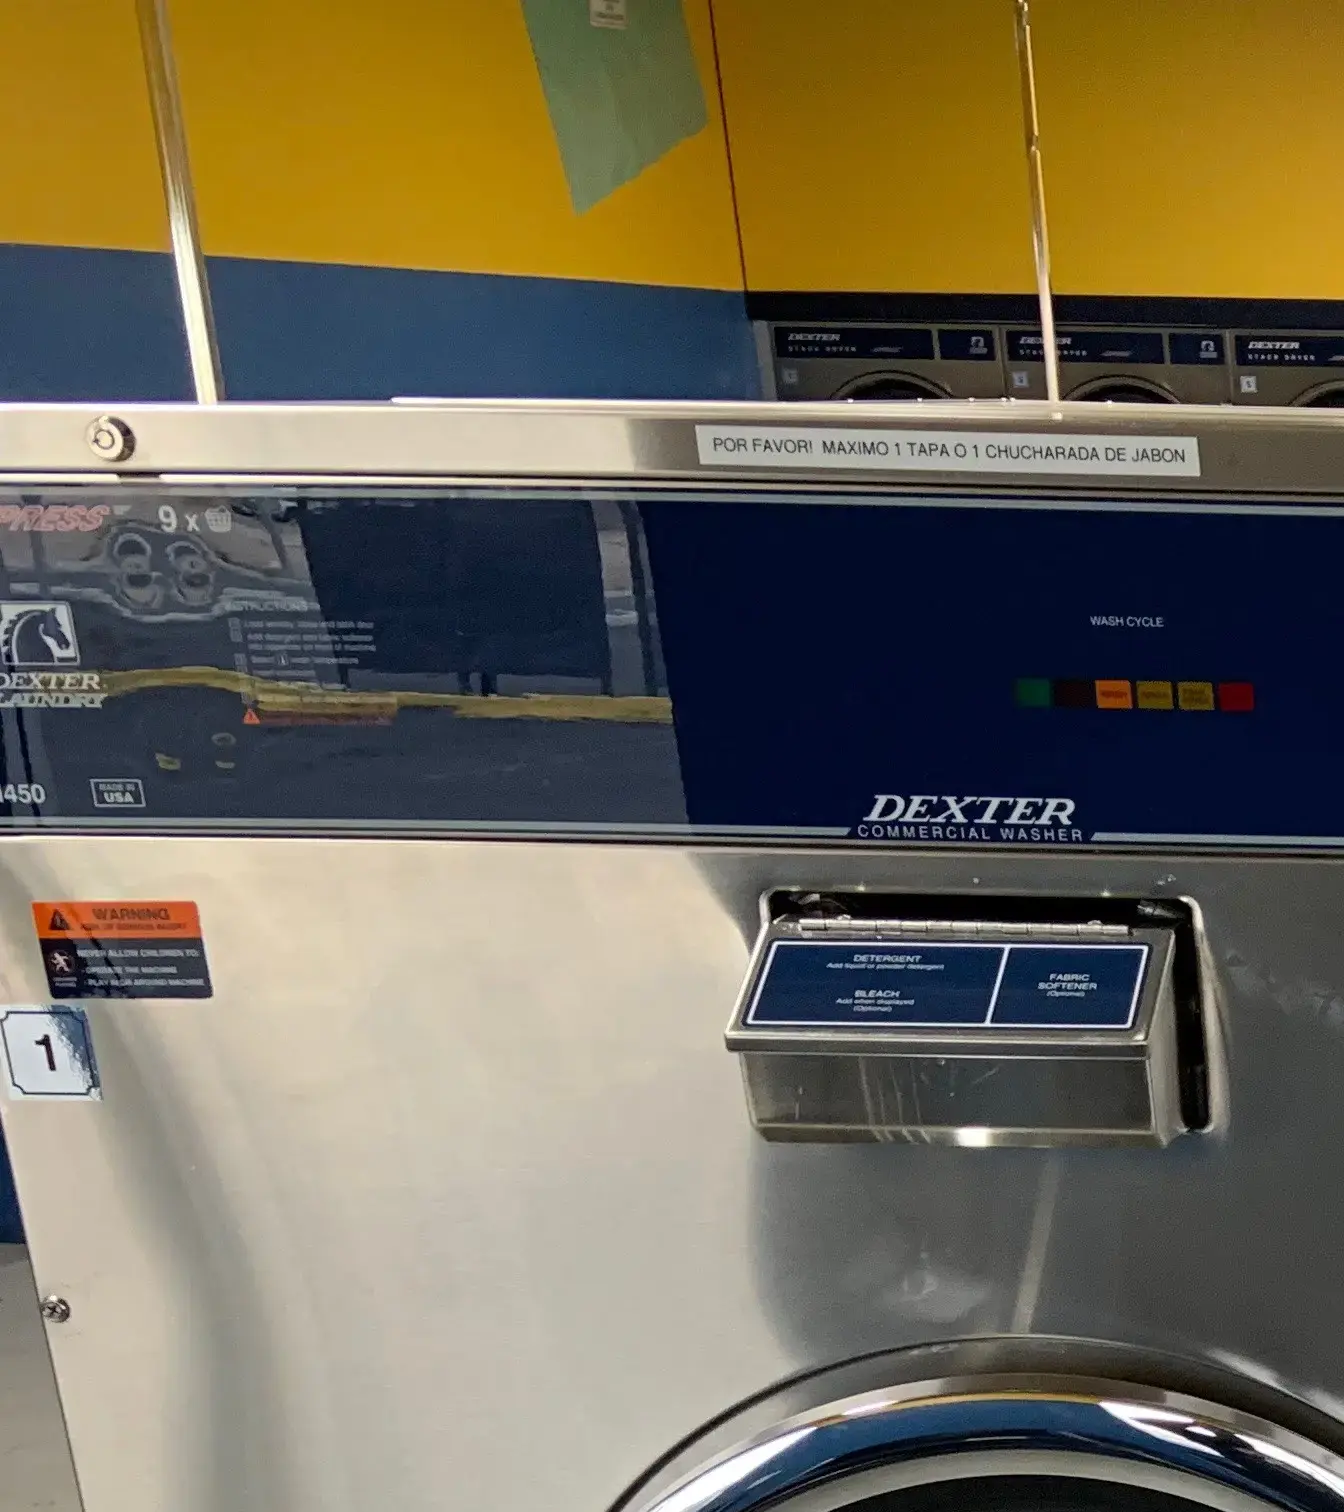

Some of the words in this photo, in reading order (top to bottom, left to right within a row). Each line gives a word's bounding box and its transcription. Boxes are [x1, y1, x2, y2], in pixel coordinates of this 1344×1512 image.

[713, 438, 748, 453] POR
[752, 439, 813, 454] FAVOR!
[822, 440, 889, 456] MAXIMO
[894, 441, 901, 456] 1
[908, 442, 950, 457] TAPA
[954, 442, 967, 458] O
[972, 443, 979, 458] 1
[985, 444, 1100, 459] CHUCHARADA
[1105, 446, 1127, 461] DE
[1131, 446, 1186, 462] JABON
[158, 506, 177, 532] 9
[1090, 616, 1124, 627] WASH
[1126, 617, 1164, 627] CYCLE
[104, 791, 134, 803] USA
[863, 794, 1076, 825] DEXTER
[858, 826, 991, 840] COMMERCIAL
[1001, 827, 1082, 841] WASHER
[92, 908, 170, 920] WARNING
[853, 954, 922, 963] DETERGENT
[1049, 973, 1090, 981] FABRIC
[1037, 982, 1097, 990] SOFTENER
[855, 989, 900, 998] BLEACH
[35, 1034, 57, 1071] 1
